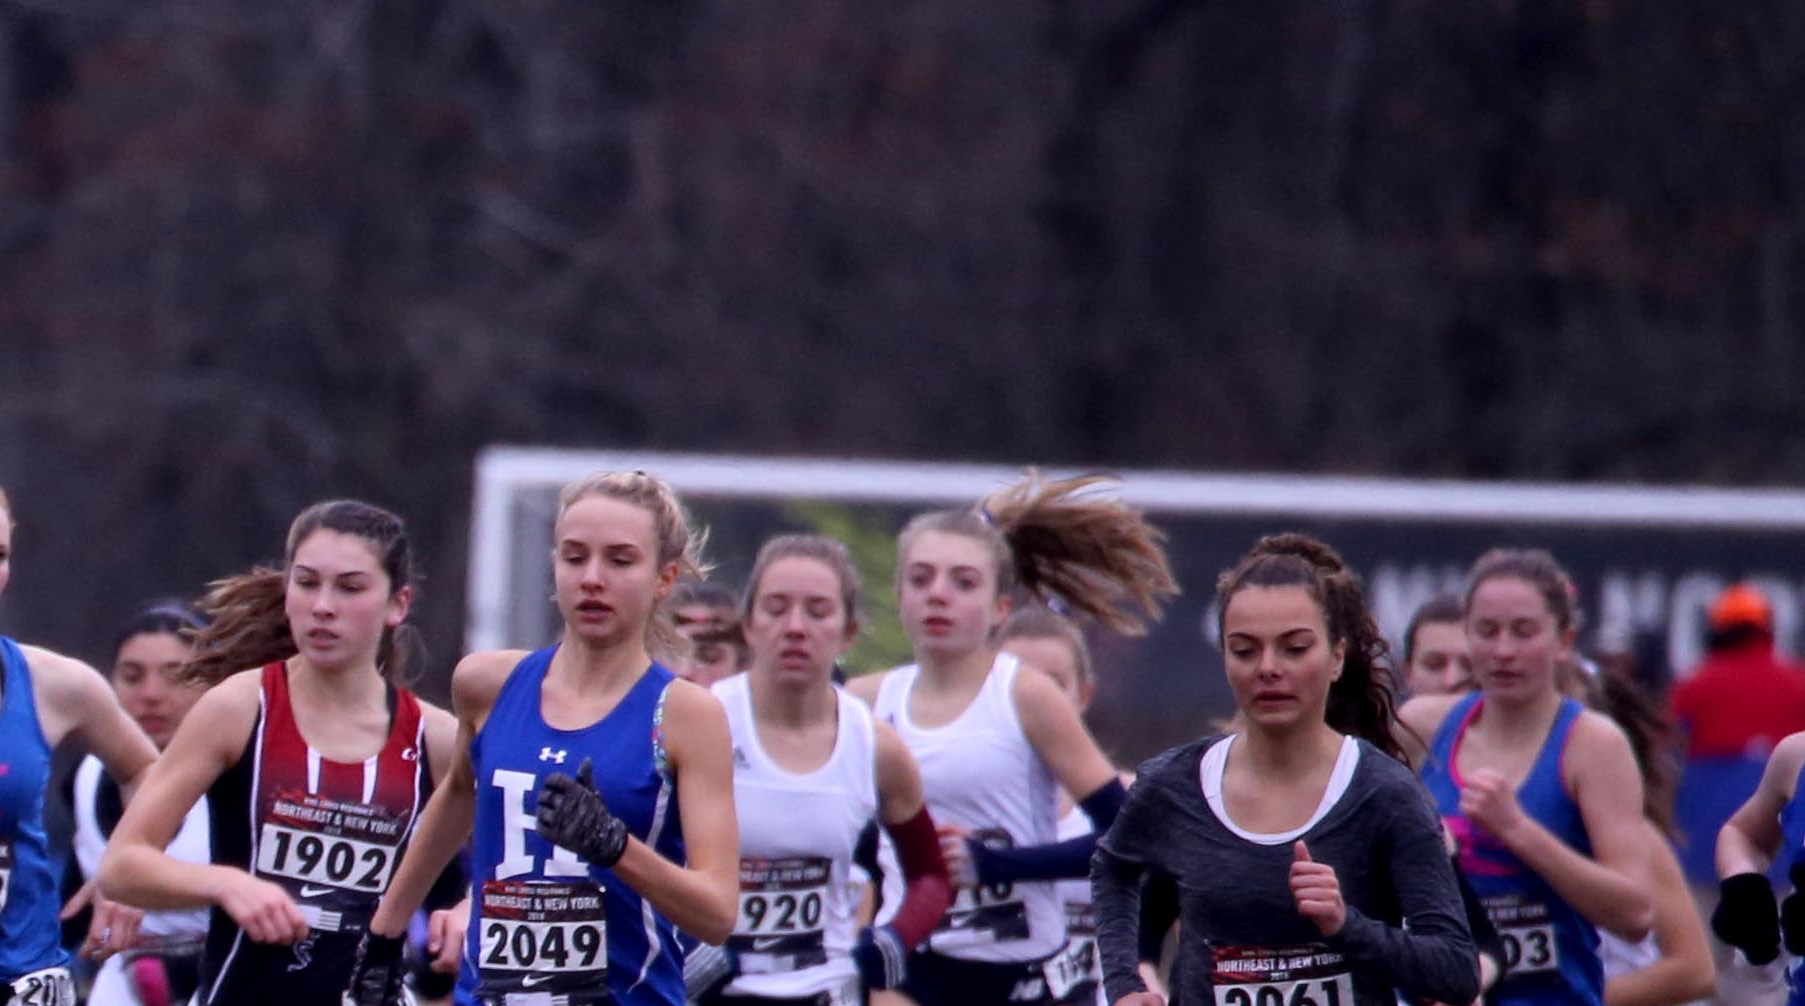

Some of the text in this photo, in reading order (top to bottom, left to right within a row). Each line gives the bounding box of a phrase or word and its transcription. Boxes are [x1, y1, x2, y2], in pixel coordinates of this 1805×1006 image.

[273, 801, 397, 835] NORTHEAST & NEW YORK
[492, 769, 589, 880] H
[273, 832, 387, 887] 1902
[484, 894, 600, 910] NORTHEAST & NEW YORK
[743, 892, 821, 930] 920
[486, 923, 601, 967] 2049
[1217, 953, 1343, 973] NORTHEAST & NEW YORK
[1503, 930, 1549, 966] 03
